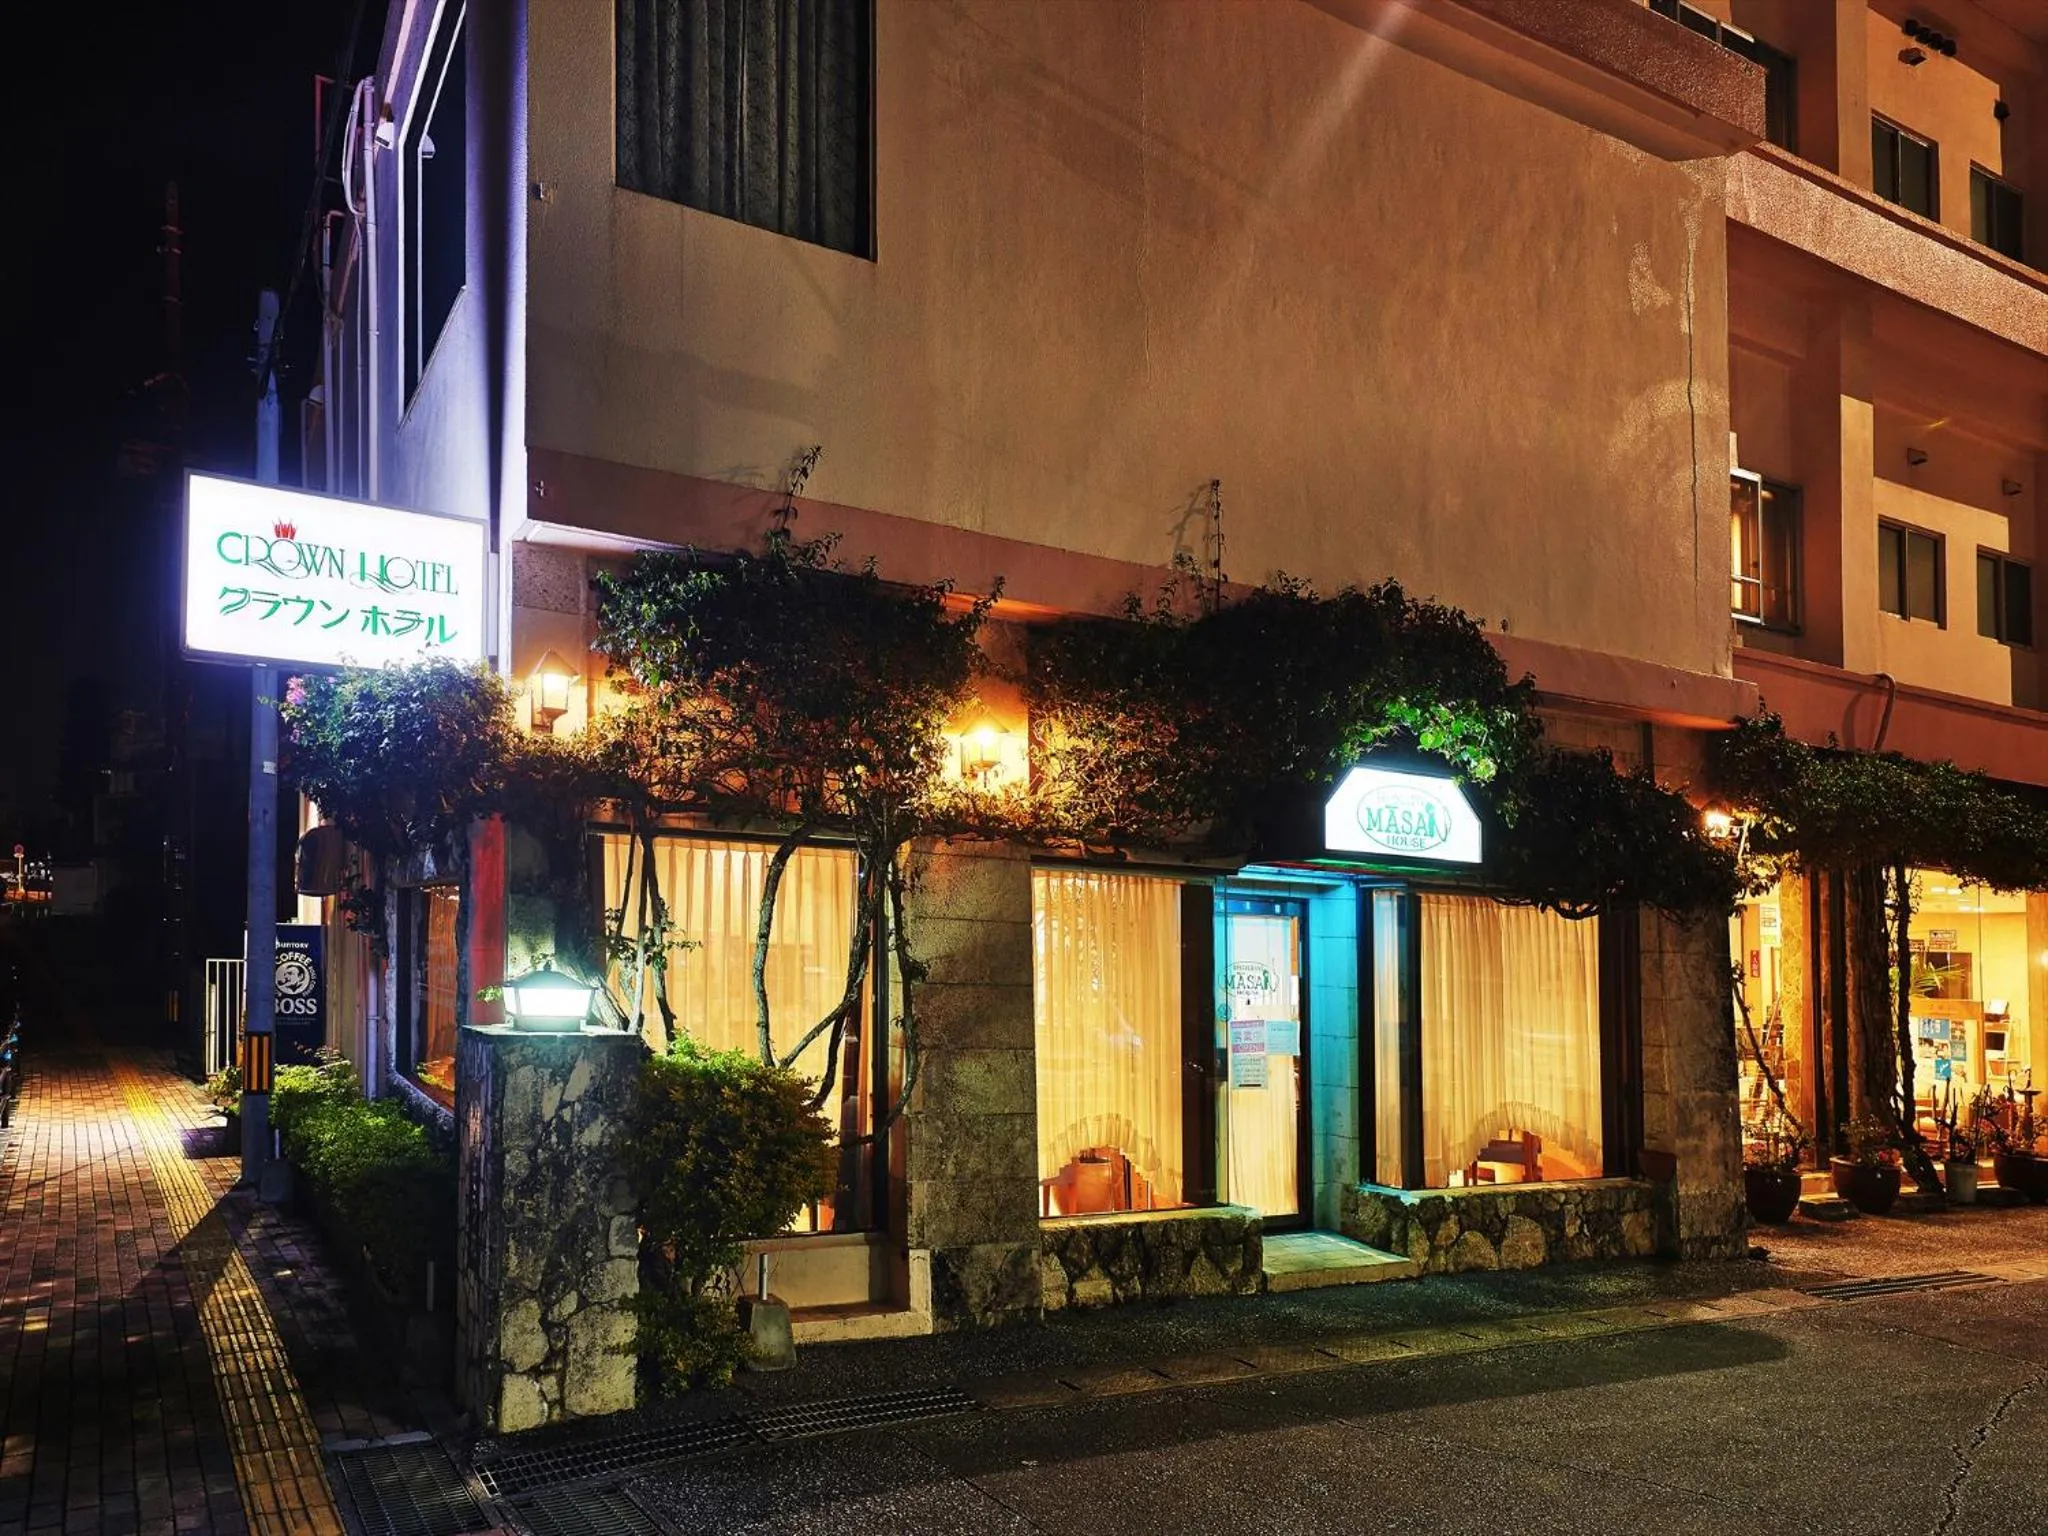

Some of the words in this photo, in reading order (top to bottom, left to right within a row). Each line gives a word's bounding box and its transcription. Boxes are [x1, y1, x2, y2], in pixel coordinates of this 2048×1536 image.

[217, 531, 346, 580] CROWN
[351, 551, 458, 596] HOTEL
[219, 586, 349, 629] クラウン
[361, 605, 458, 643] ホテル
